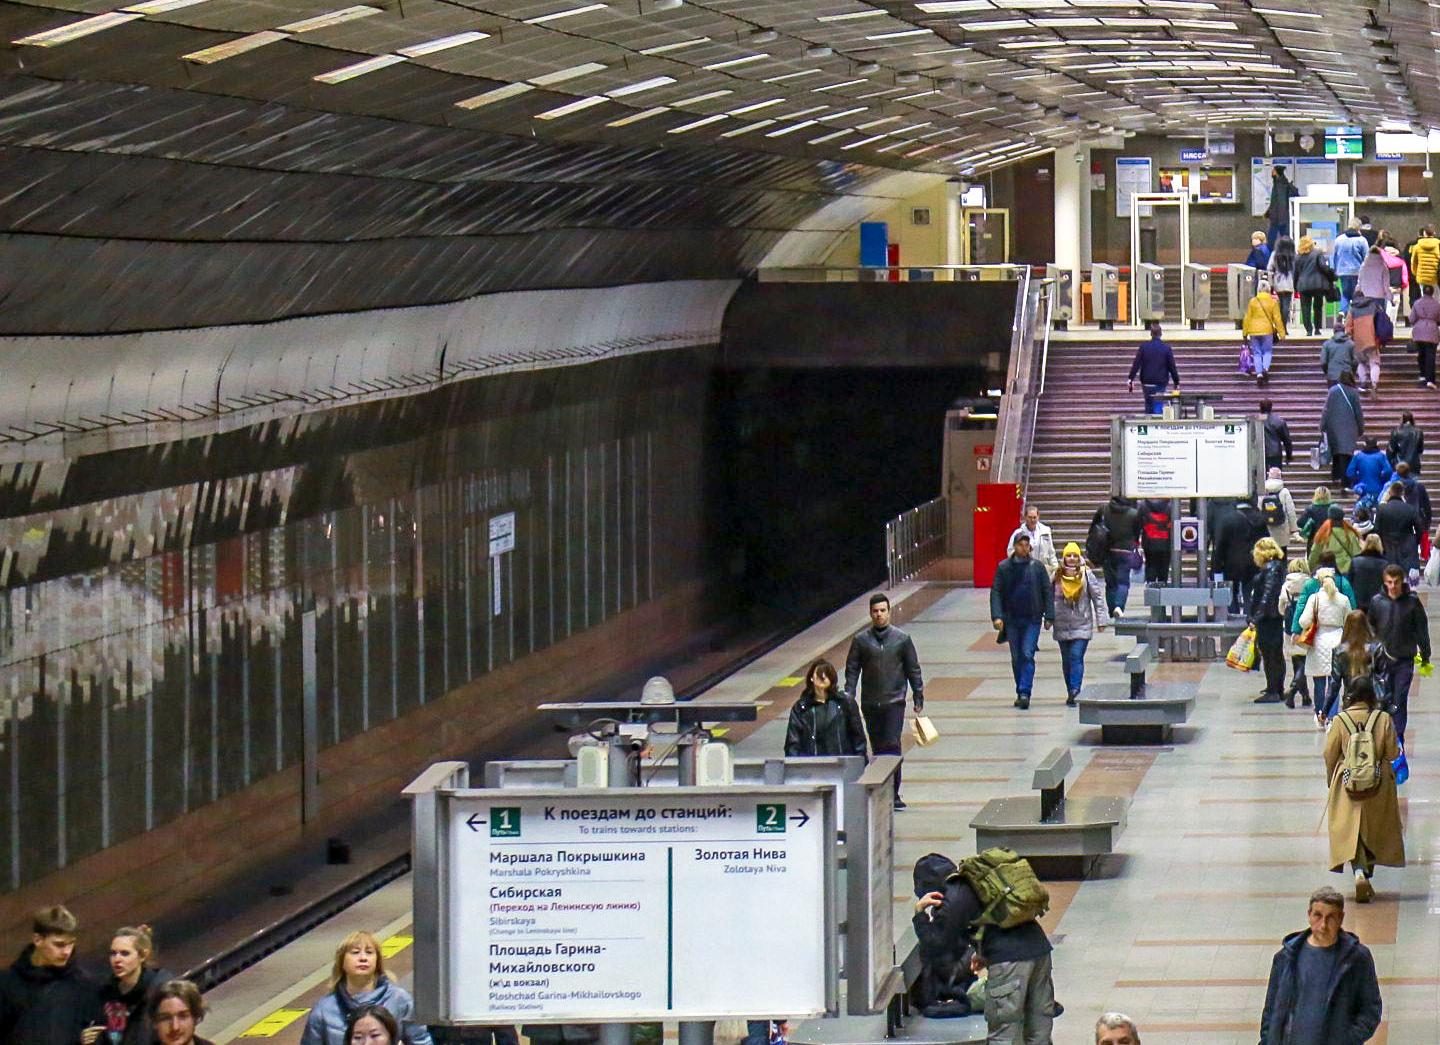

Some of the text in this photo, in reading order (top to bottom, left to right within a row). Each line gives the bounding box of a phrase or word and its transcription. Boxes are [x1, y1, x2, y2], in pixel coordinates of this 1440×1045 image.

[499, 810, 513, 829] 1
[544, 804, 733, 822] К поездам до станций:
[766, 805, 778, 825] 2
[579, 825, 698, 834] To trains towards stations:
[490, 850, 646, 865] Маршала Покрышкина
[695, 848, 787, 861] Золотая Нива
[490, 867, 591, 878] Marshala Pokryshkina
[723, 864, 787, 875] Zolotaya Niva
[489, 886, 562, 900] Сибирская
[489, 901, 641, 914] (Переход на Ленинскую линию)
[489, 917, 536, 927] Sibirskaya
[489, 943, 606, 957] Площадь Гарина-
[489, 960, 595, 974] Михайловского
[513, 978, 550, 988] вокзал)
[489, 990, 642, 1001] Ploshchad Garina-Mikhailovskogo
